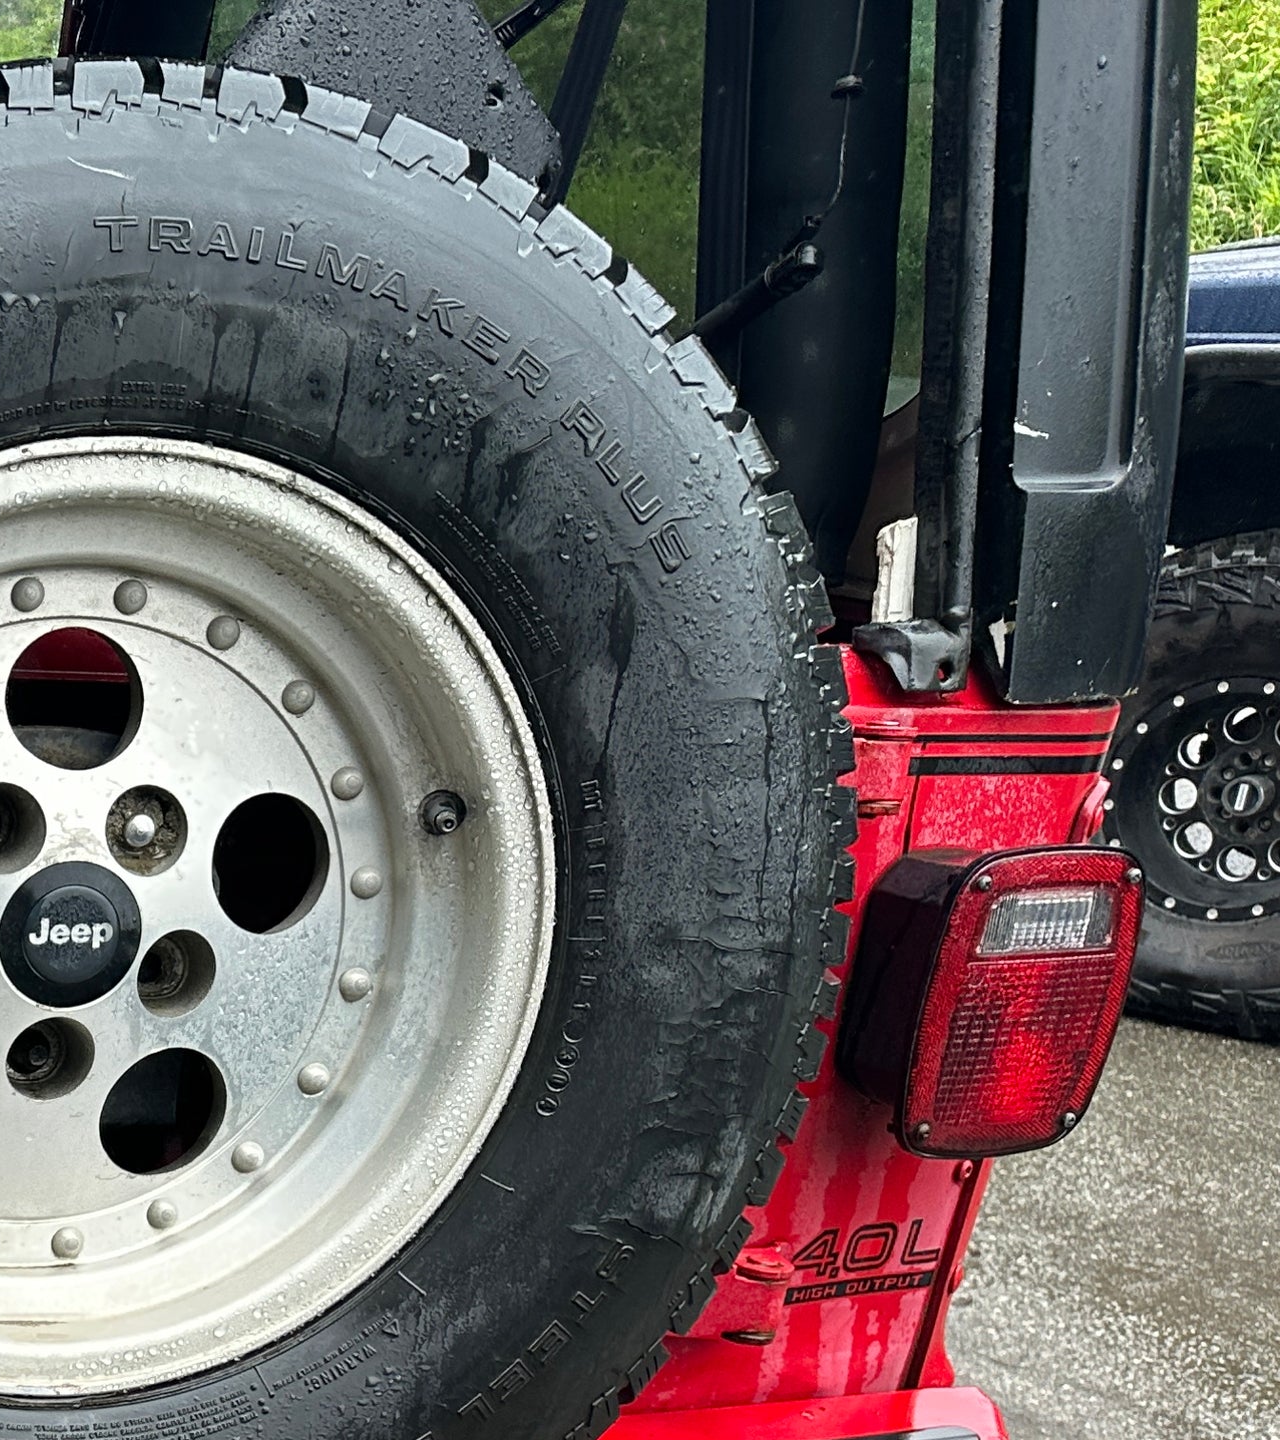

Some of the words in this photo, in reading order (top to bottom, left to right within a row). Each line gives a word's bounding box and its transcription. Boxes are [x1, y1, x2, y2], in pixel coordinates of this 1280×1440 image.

[93, 214, 552, 399] TRAILMAKER
[559, 399, 693, 574] PLUS
[29, 917, 114, 949] Jeep
[792, 1219, 941, 1279] 4.0L
[791, 1286, 836, 1301] HIGH
[845, 1273, 924, 1294] OUTPUT
[458, 1245, 636, 1416] STEEL
